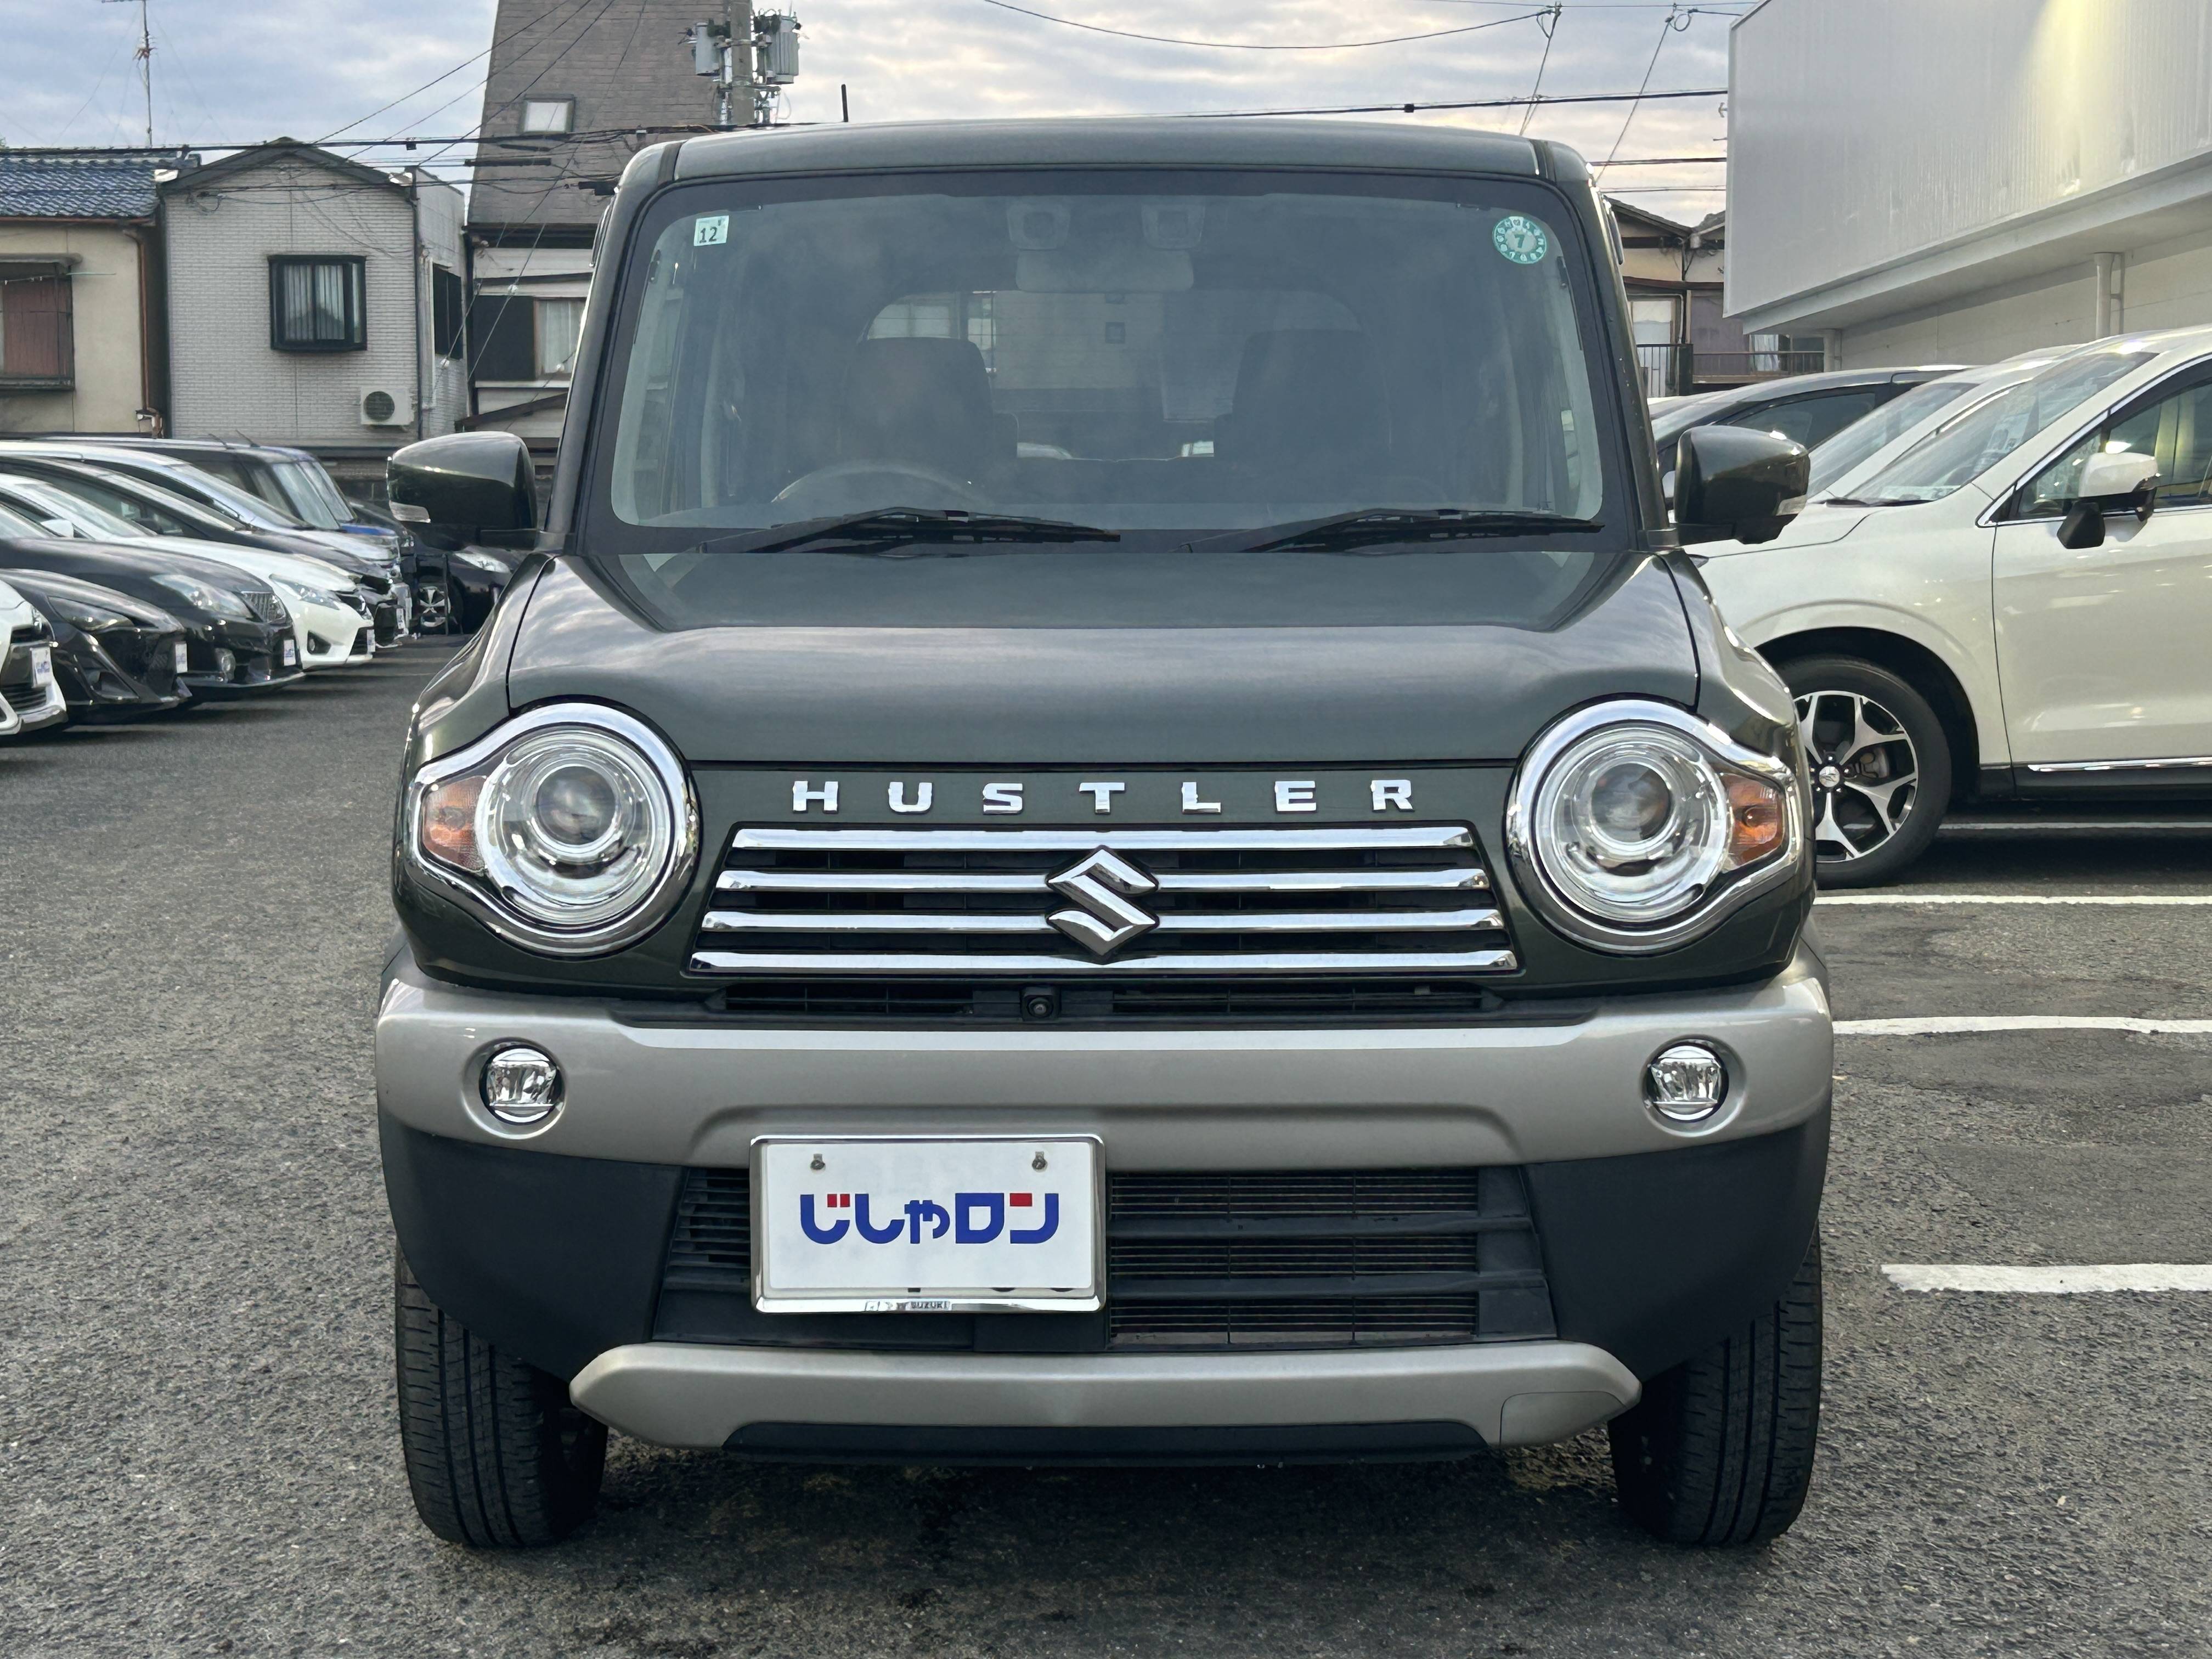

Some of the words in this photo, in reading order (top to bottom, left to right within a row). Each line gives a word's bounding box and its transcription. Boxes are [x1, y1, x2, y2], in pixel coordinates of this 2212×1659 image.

[699, 226, 718, 243] 12
[1514, 234, 1526, 249] 7
[793, 780, 1413, 814] HUSTLER
[800, 1192, 1059, 1244] じしゃロン
[911, 1301, 948, 1309] SUZUKI
